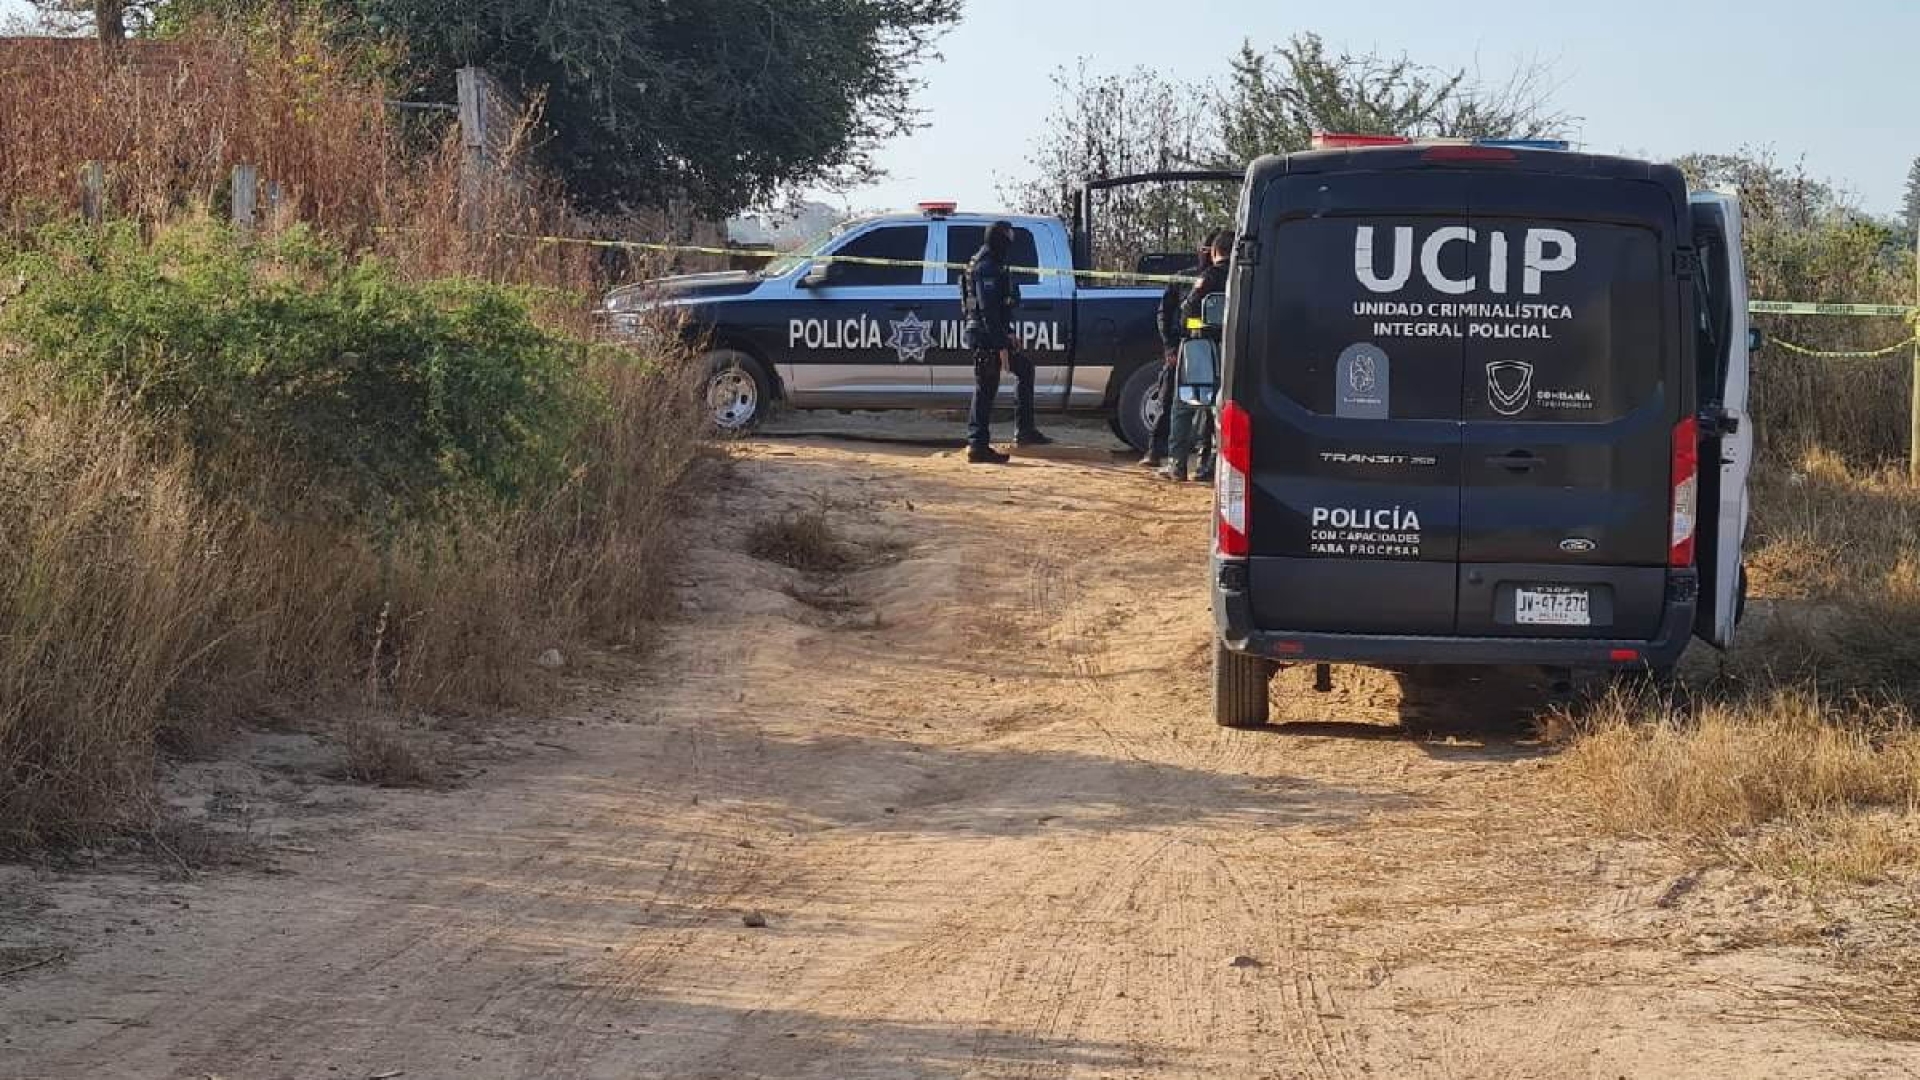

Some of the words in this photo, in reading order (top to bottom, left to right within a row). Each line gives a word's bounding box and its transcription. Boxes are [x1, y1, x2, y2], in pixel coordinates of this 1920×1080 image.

[1354, 226, 1577, 294] UCIP
[1353, 302, 1423, 315] UNIDAD
[1428, 302, 1572, 319] CRIMINALÍSTICA
[789, 313, 883, 348] POLICÍA
[940, 320, 1065, 350] MUIPAL
[1373, 322, 1463, 337] INTEGRAL
[1469, 324, 1552, 339] POLICIAL
[1320, 452, 1408, 463] TRANSIT
[1312, 505, 1421, 531] POLICÍA
[1311, 530, 1337, 540] CON
[1338, 532, 1420, 544] CAPACIDADES
[1311, 543, 1345, 553] PARA
[1349, 543, 1419, 556] PROCESAR
